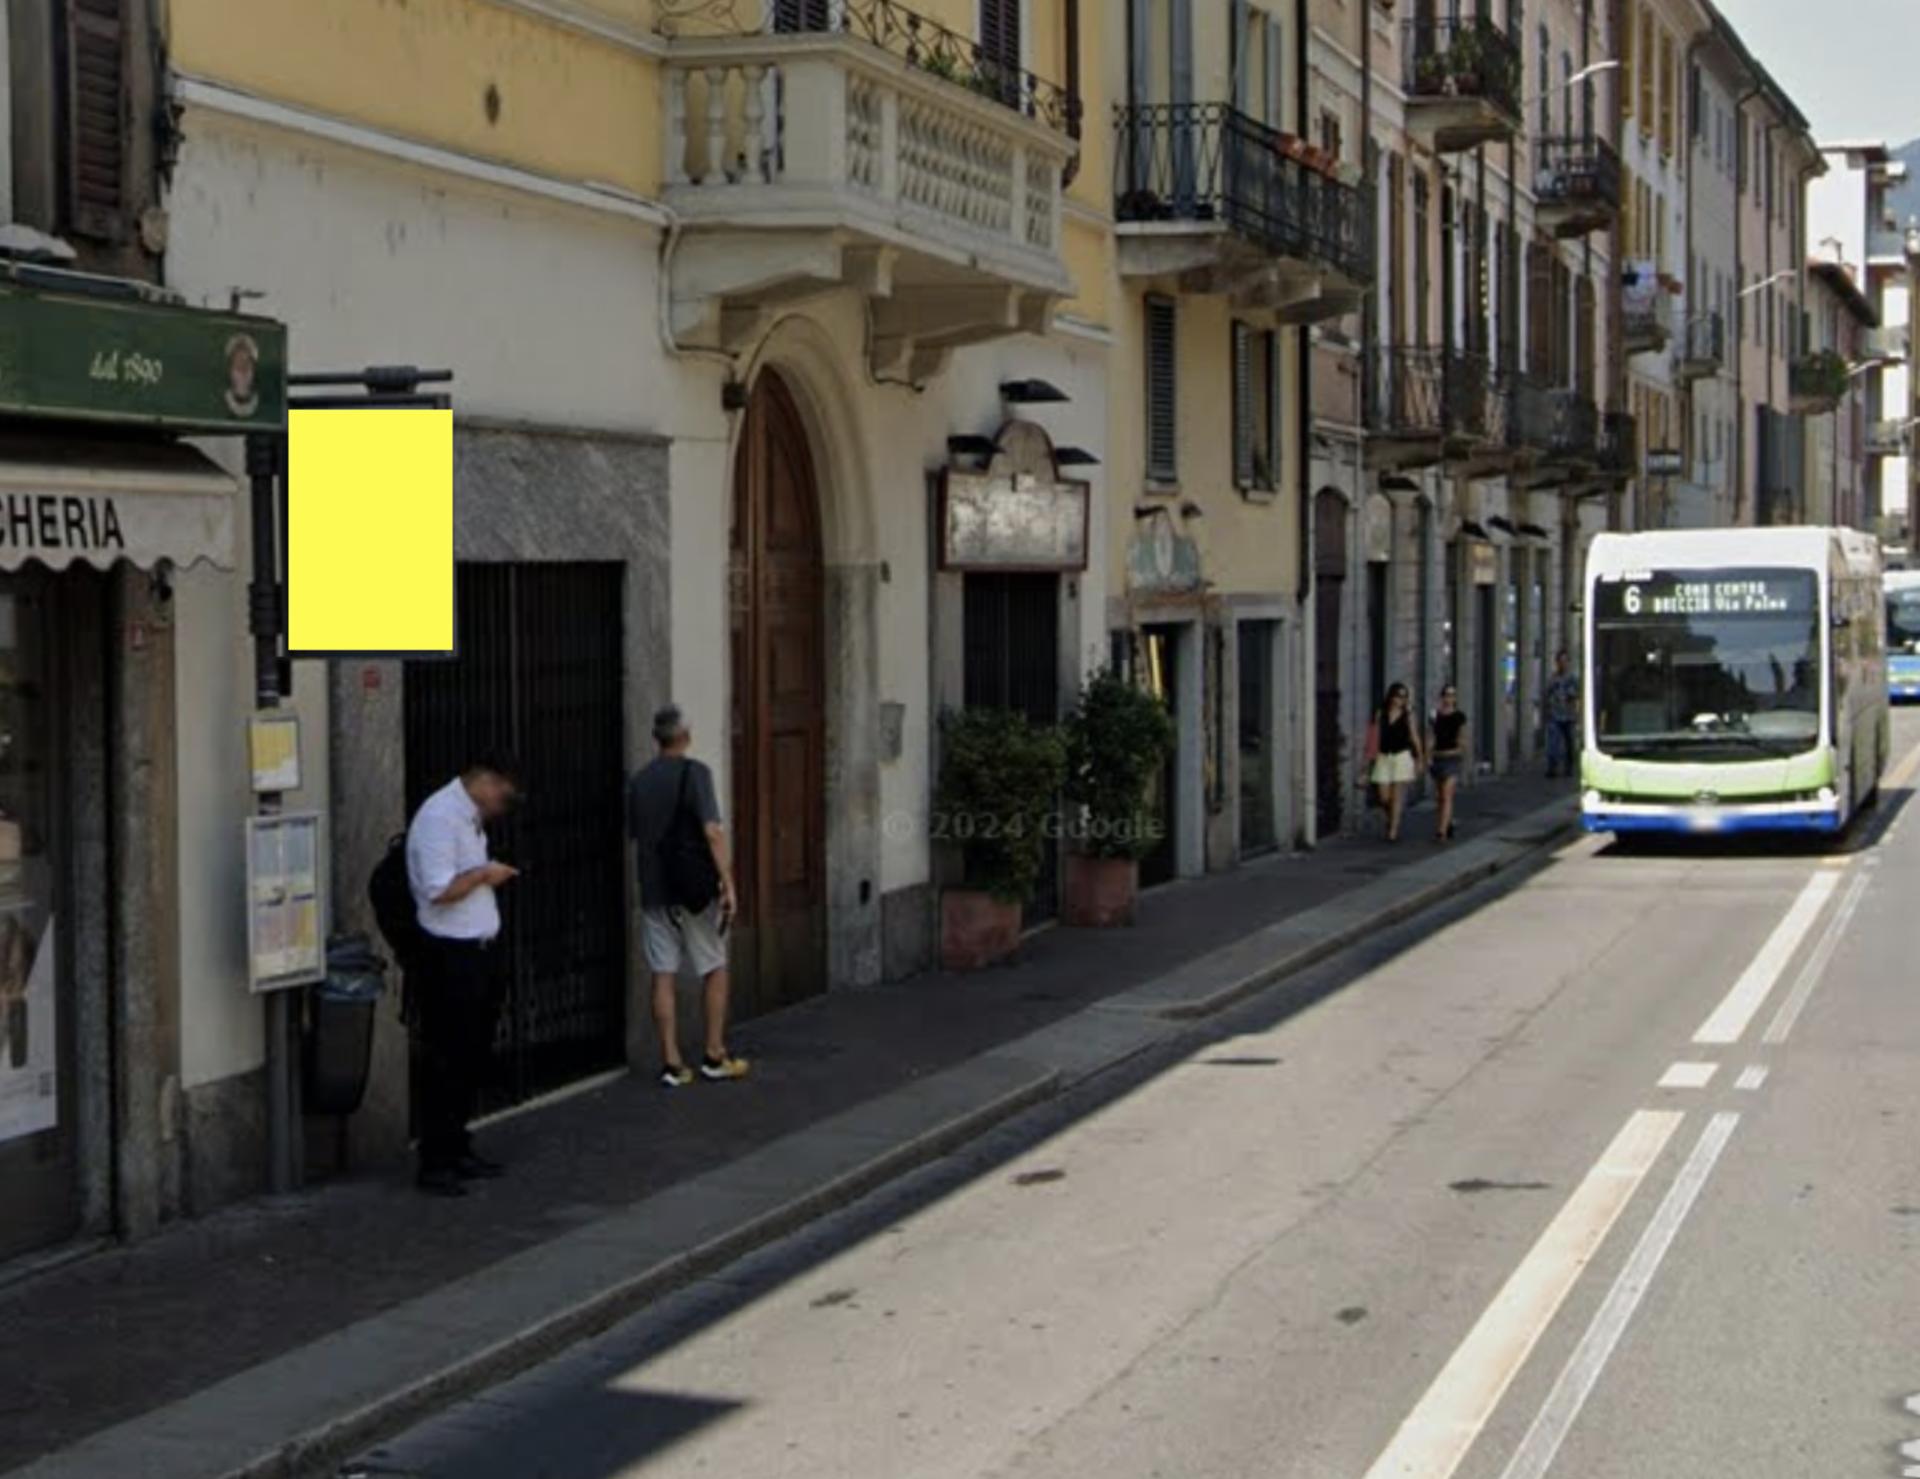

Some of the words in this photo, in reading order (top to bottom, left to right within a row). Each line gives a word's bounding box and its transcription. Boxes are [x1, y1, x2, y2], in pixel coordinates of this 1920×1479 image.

[124, 352, 163, 386] 1890
[0, 494, 124, 549] HERIA
[1624, 585, 1641, 614] 6
[1714, 581, 1767, 596] CENTRO
